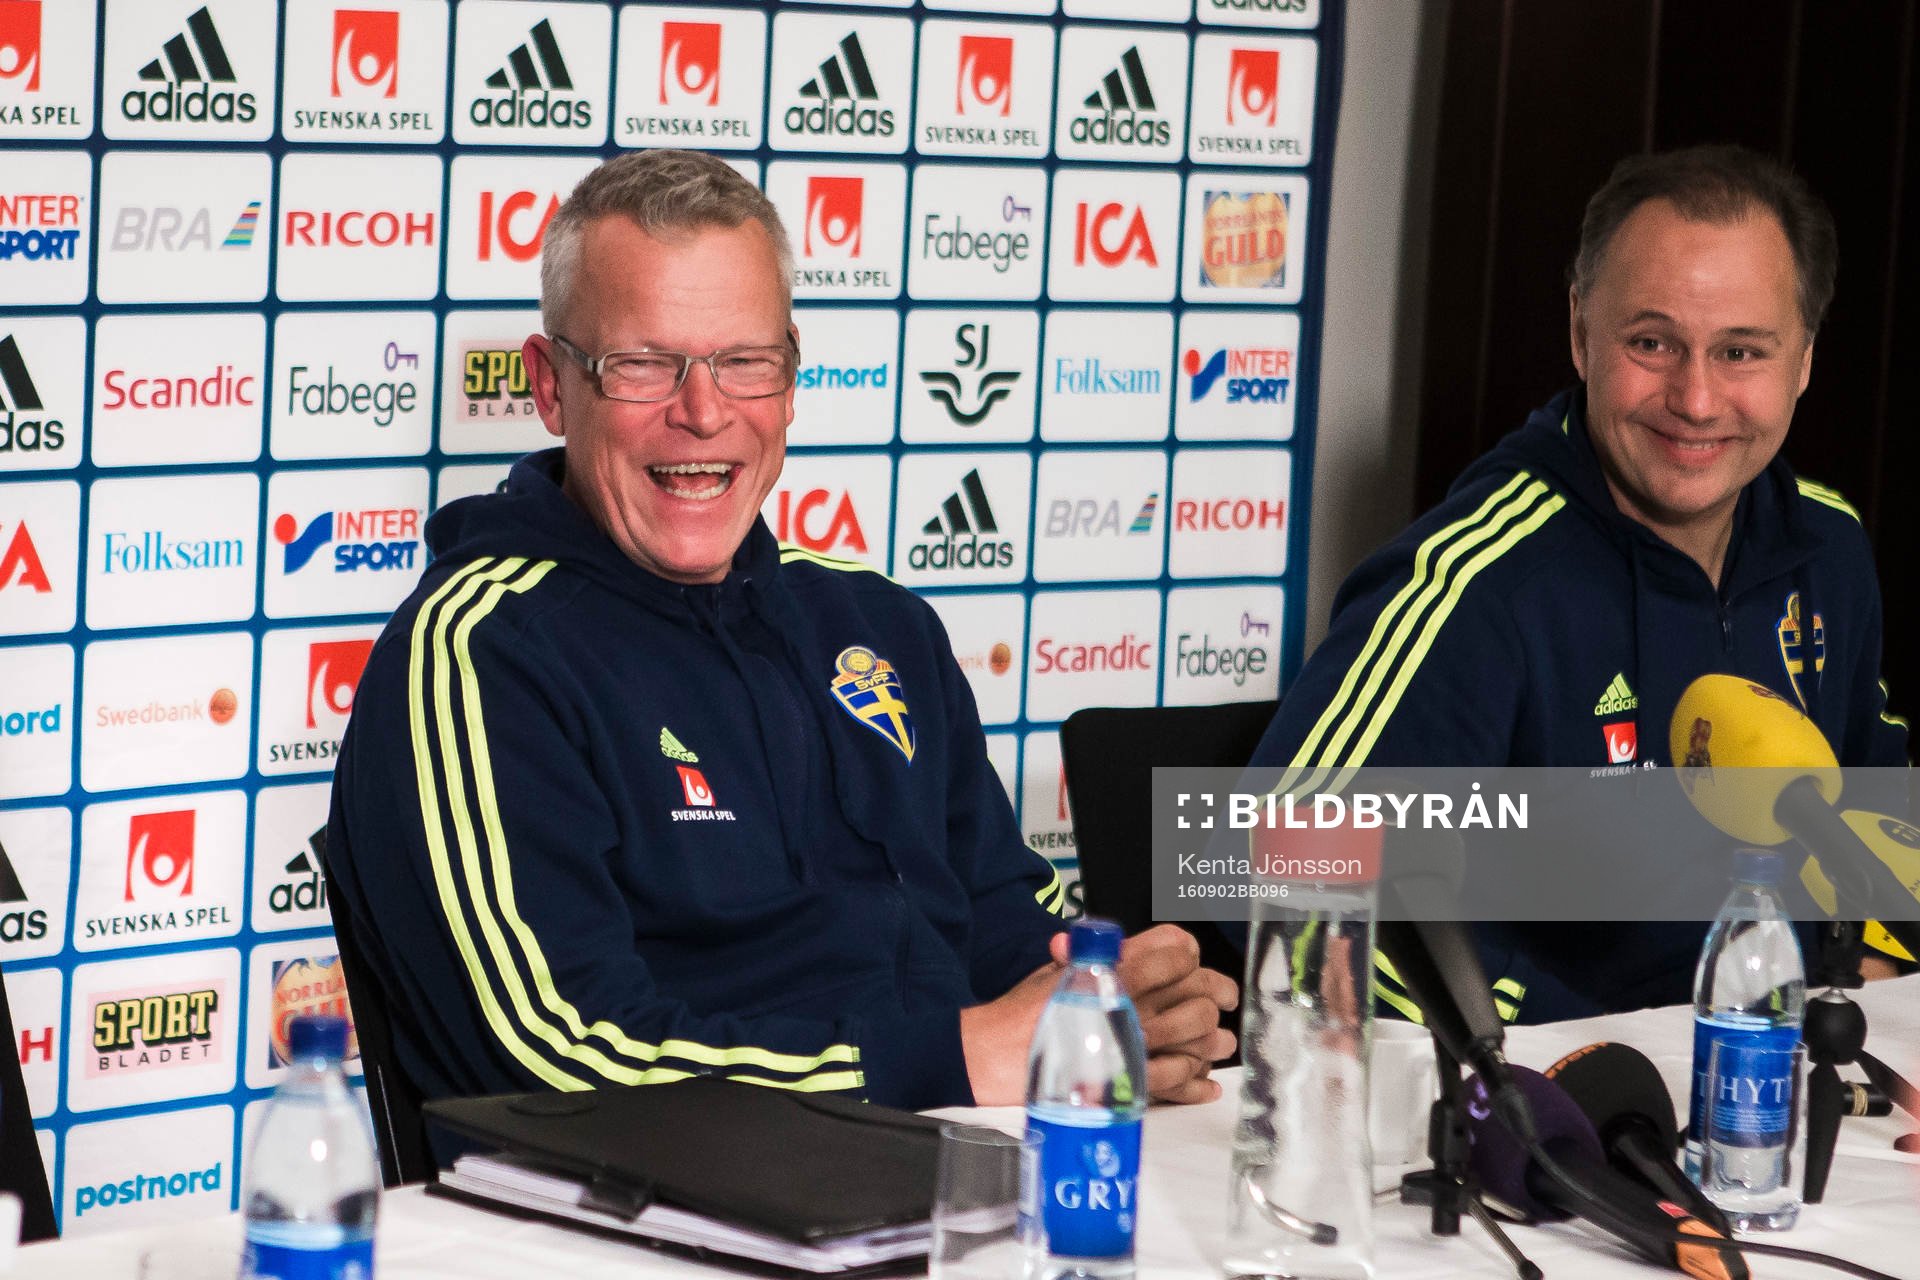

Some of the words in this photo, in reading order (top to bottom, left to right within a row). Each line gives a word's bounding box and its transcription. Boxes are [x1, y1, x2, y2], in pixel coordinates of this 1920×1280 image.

[31, 106, 80, 125] SPEL
[121, 81, 257, 123] adidas
[469, 90, 592, 129] adidas
[784, 100, 895, 137] adidas
[294, 110, 381, 130] SVENSKA
[389, 111, 433, 131] SPEL
[625, 117, 704, 136] SVENSKA
[711, 119, 751, 138] SPEL
[925, 126, 997, 145] SVENSKA
[1003, 129, 1039, 147] SPEL
[1070, 109, 1171, 146] adidas
[1198, 136, 1263, 154] SVENSKA
[1269, 138, 1303, 155] SPEL
[0, 195, 79, 226] NTER
[110, 207, 212, 251] BRA
[285, 211, 434, 247] RICOH
[923, 214, 1029, 273] Fabege
[1074, 202, 1159, 268] ICA
[1204, 229, 1285, 266] GULD
[793, 270, 847, 287] ENSKA
[853, 271, 892, 287] SPEL
[954, 323, 990, 371] SJ
[1227, 349, 1290, 377] INTER
[103, 365, 255, 411] Scandic
[464, 350, 531, 400] SPO
[796, 362, 888, 389] stnord
[1053, 358, 1161, 394] Folksam
[1226, 378, 1290, 404] SPORT
[288, 366, 417, 427] Fabege
[468, 402, 534, 416] BLAD
[0, 411, 64, 452] das
[336, 509, 419, 541] INTER
[777, 488, 868, 554] ICA
[1044, 499, 1121, 538] BRA
[1175, 500, 1285, 532] RICOH
[102, 530, 244, 574] Folksam
[334, 541, 419, 573] SPORT
[908, 534, 1014, 571] adidas
[1035, 634, 1152, 673] Scandic
[1176, 633, 1268, 687] Fabege
[96, 698, 205, 727] Swedbank
[1594, 697, 1638, 716] adidas
[270, 739, 343, 763] SVENSK
[1590, 765, 1631, 779] SVENSKA
[671, 810, 715, 821] SVENSKA
[715, 810, 736, 821] SPEL
[1029, 832, 1075, 848] SVENS
[269, 872, 326, 914] adi
[86, 912, 177, 938] SVENSKA
[184, 906, 231, 928] SPEL
[93, 989, 218, 1053] SPORT
[99, 1044, 212, 1070] BLADET
[76, 1161, 222, 1217] postnord
